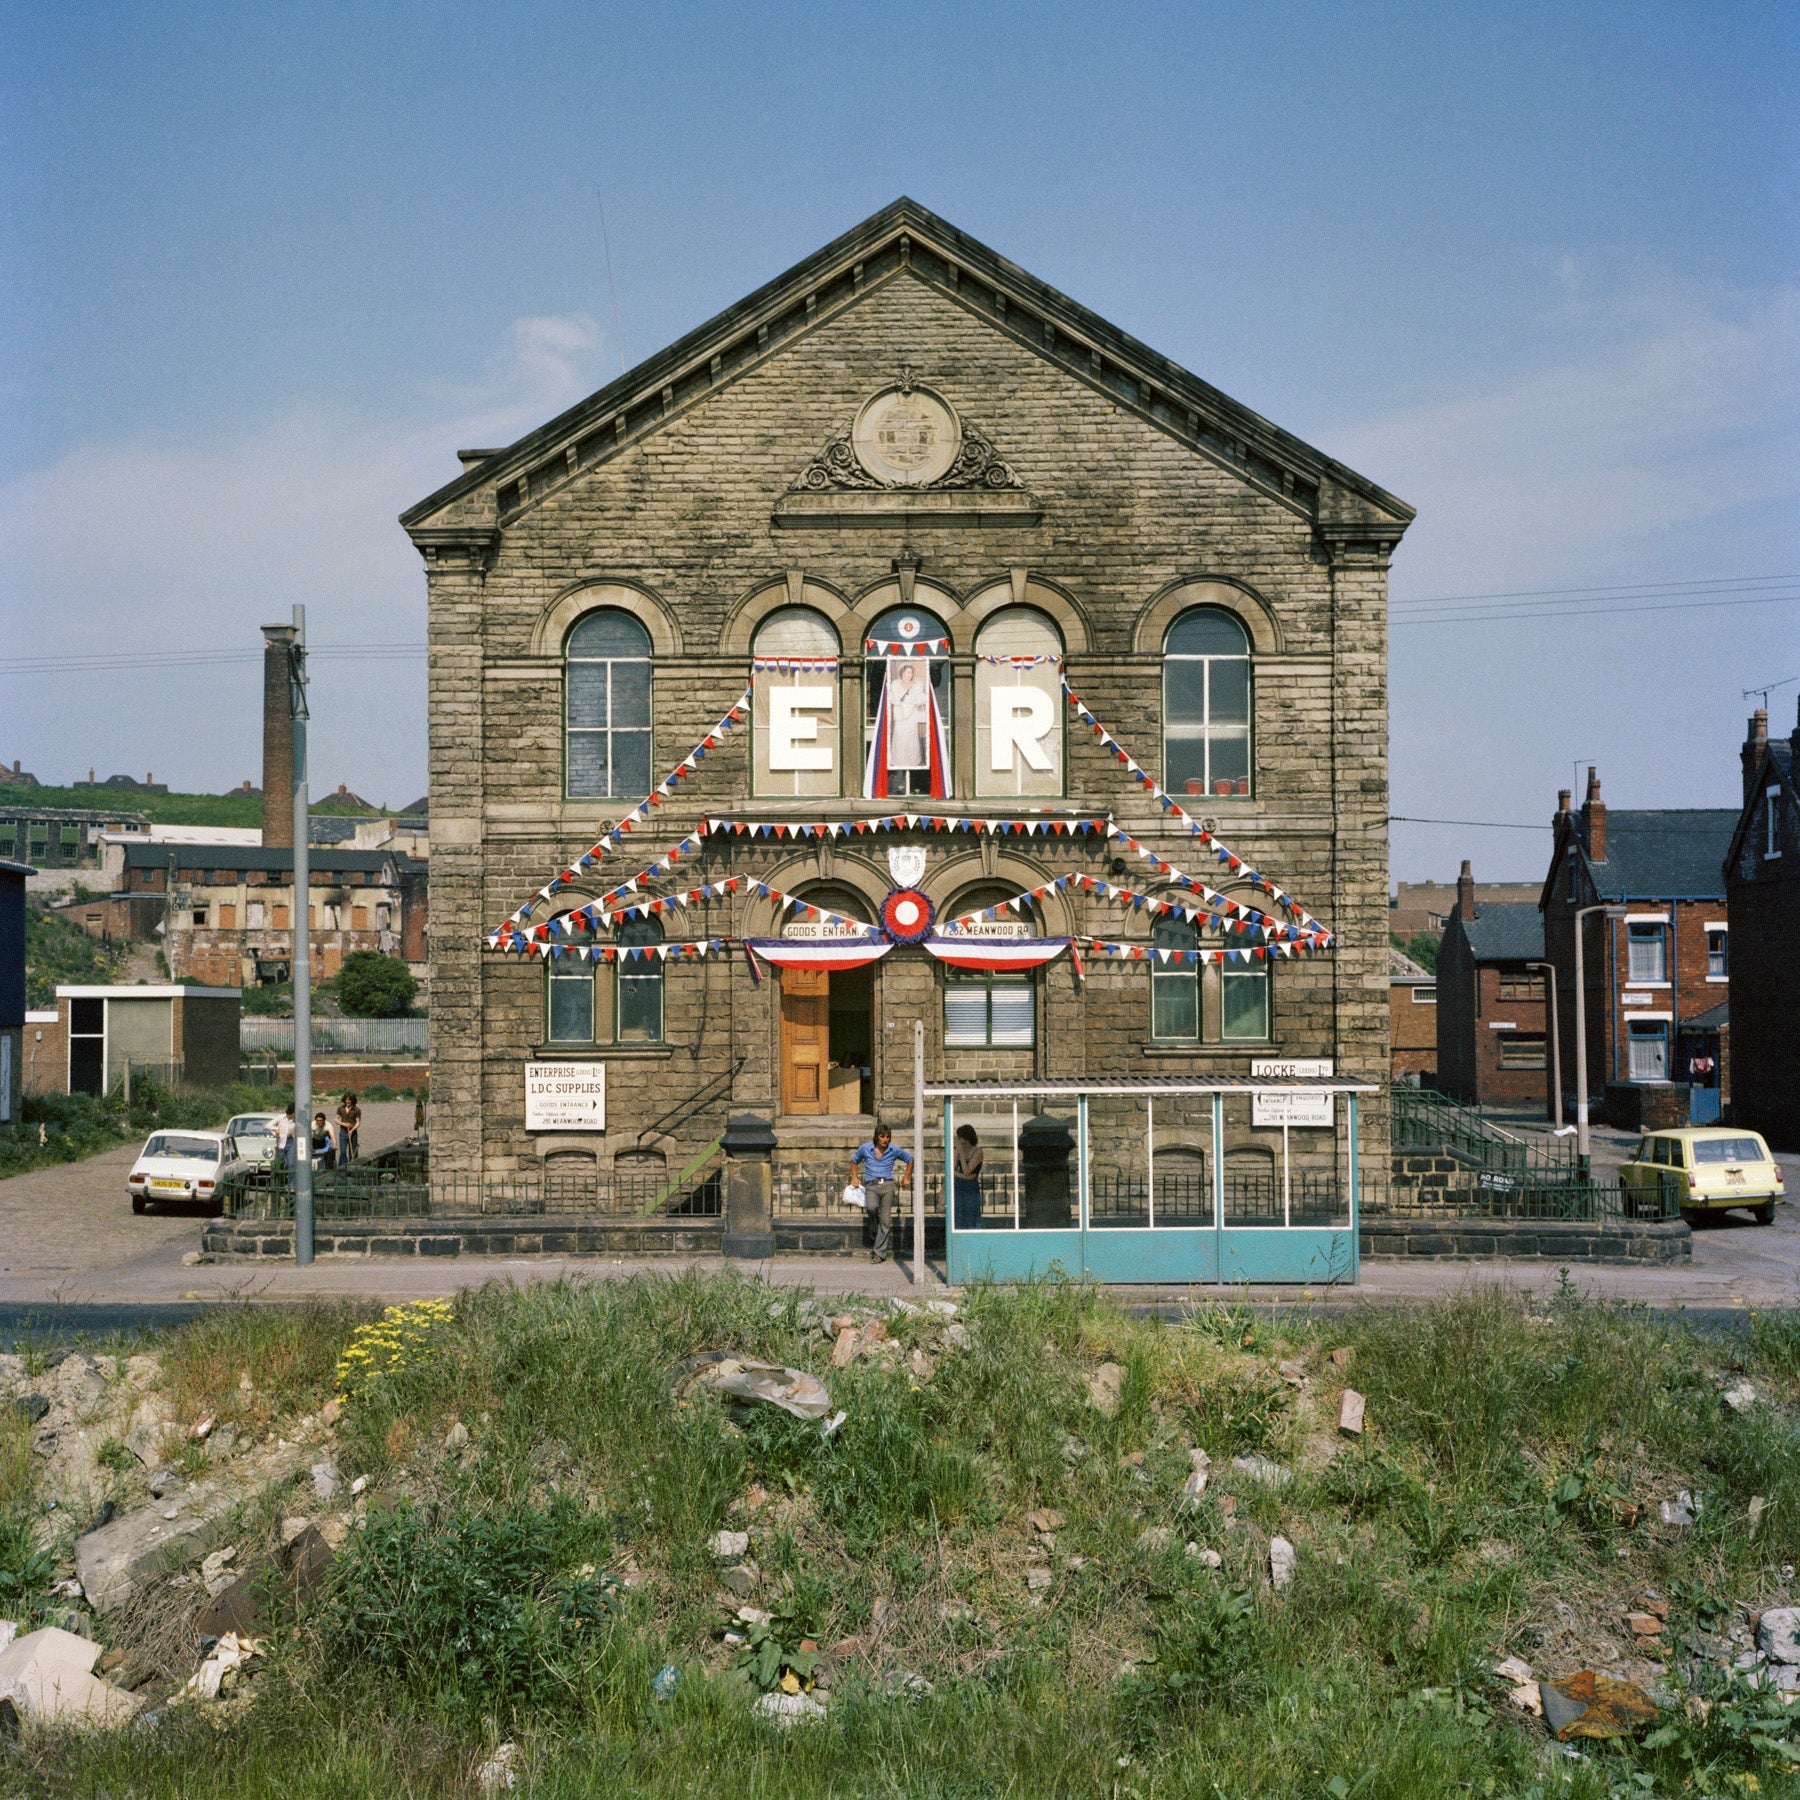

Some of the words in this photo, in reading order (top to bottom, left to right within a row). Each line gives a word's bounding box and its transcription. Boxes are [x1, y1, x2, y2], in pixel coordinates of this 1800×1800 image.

[769, 686, 833, 770] E
[990, 686, 1055, 770] R
[787, 926, 817, 937] GOODS
[966, 925, 1013, 936] MEANWOOD
[529, 1067, 576, 1078] ENTERPRISE
[1256, 1065, 1296, 1077] LOCKE
[555, 1083, 601, 1094] SUPPLIES
